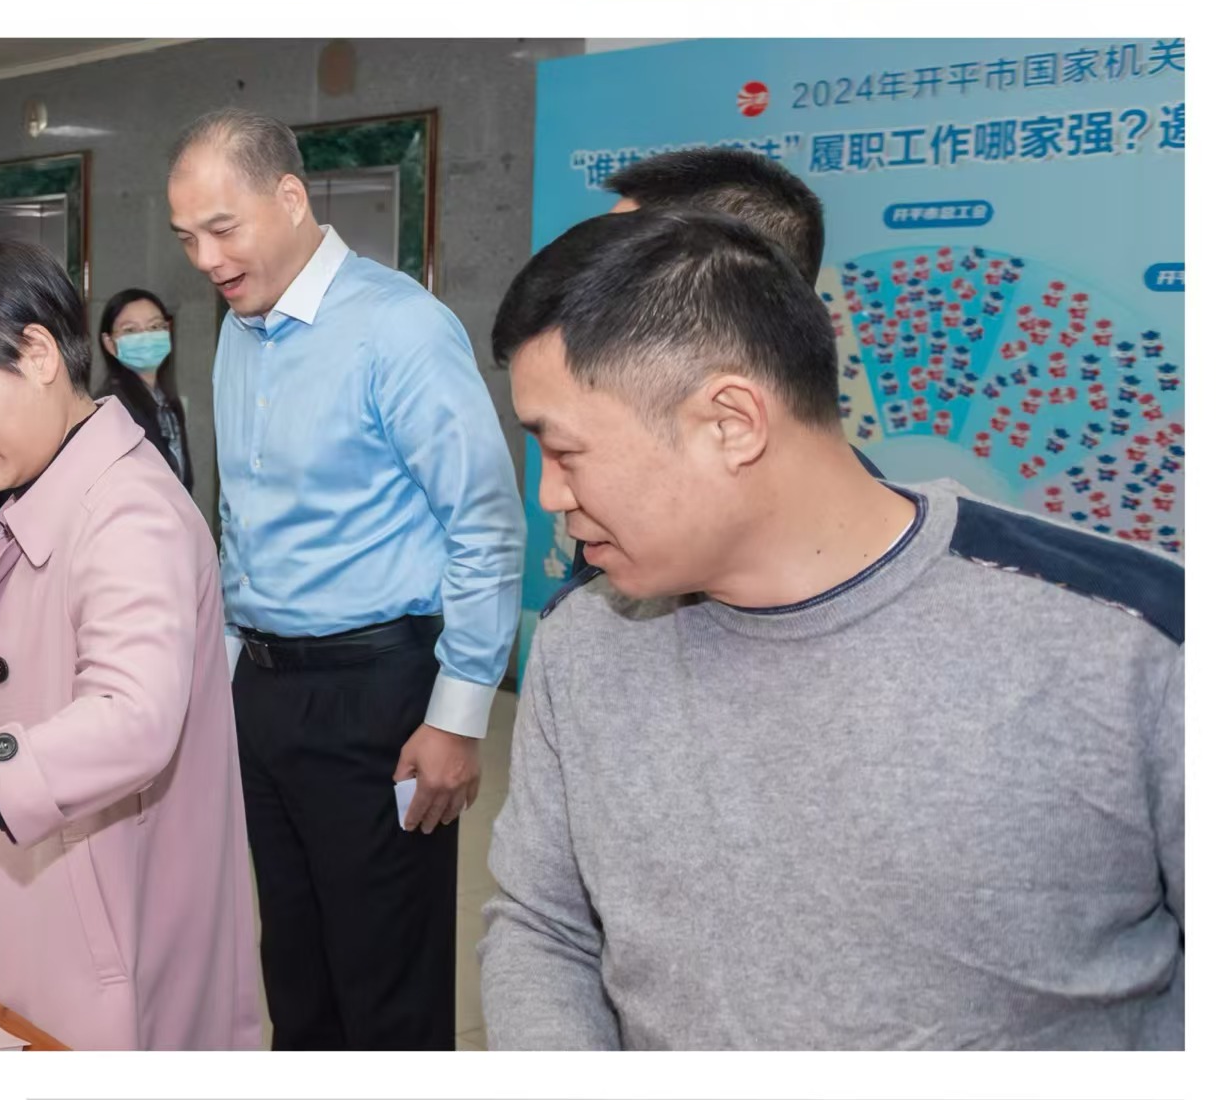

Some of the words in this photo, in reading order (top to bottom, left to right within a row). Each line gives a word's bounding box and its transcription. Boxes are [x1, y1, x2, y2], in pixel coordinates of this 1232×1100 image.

[791, 38, 1185, 109] 2024年开平市国家机关
